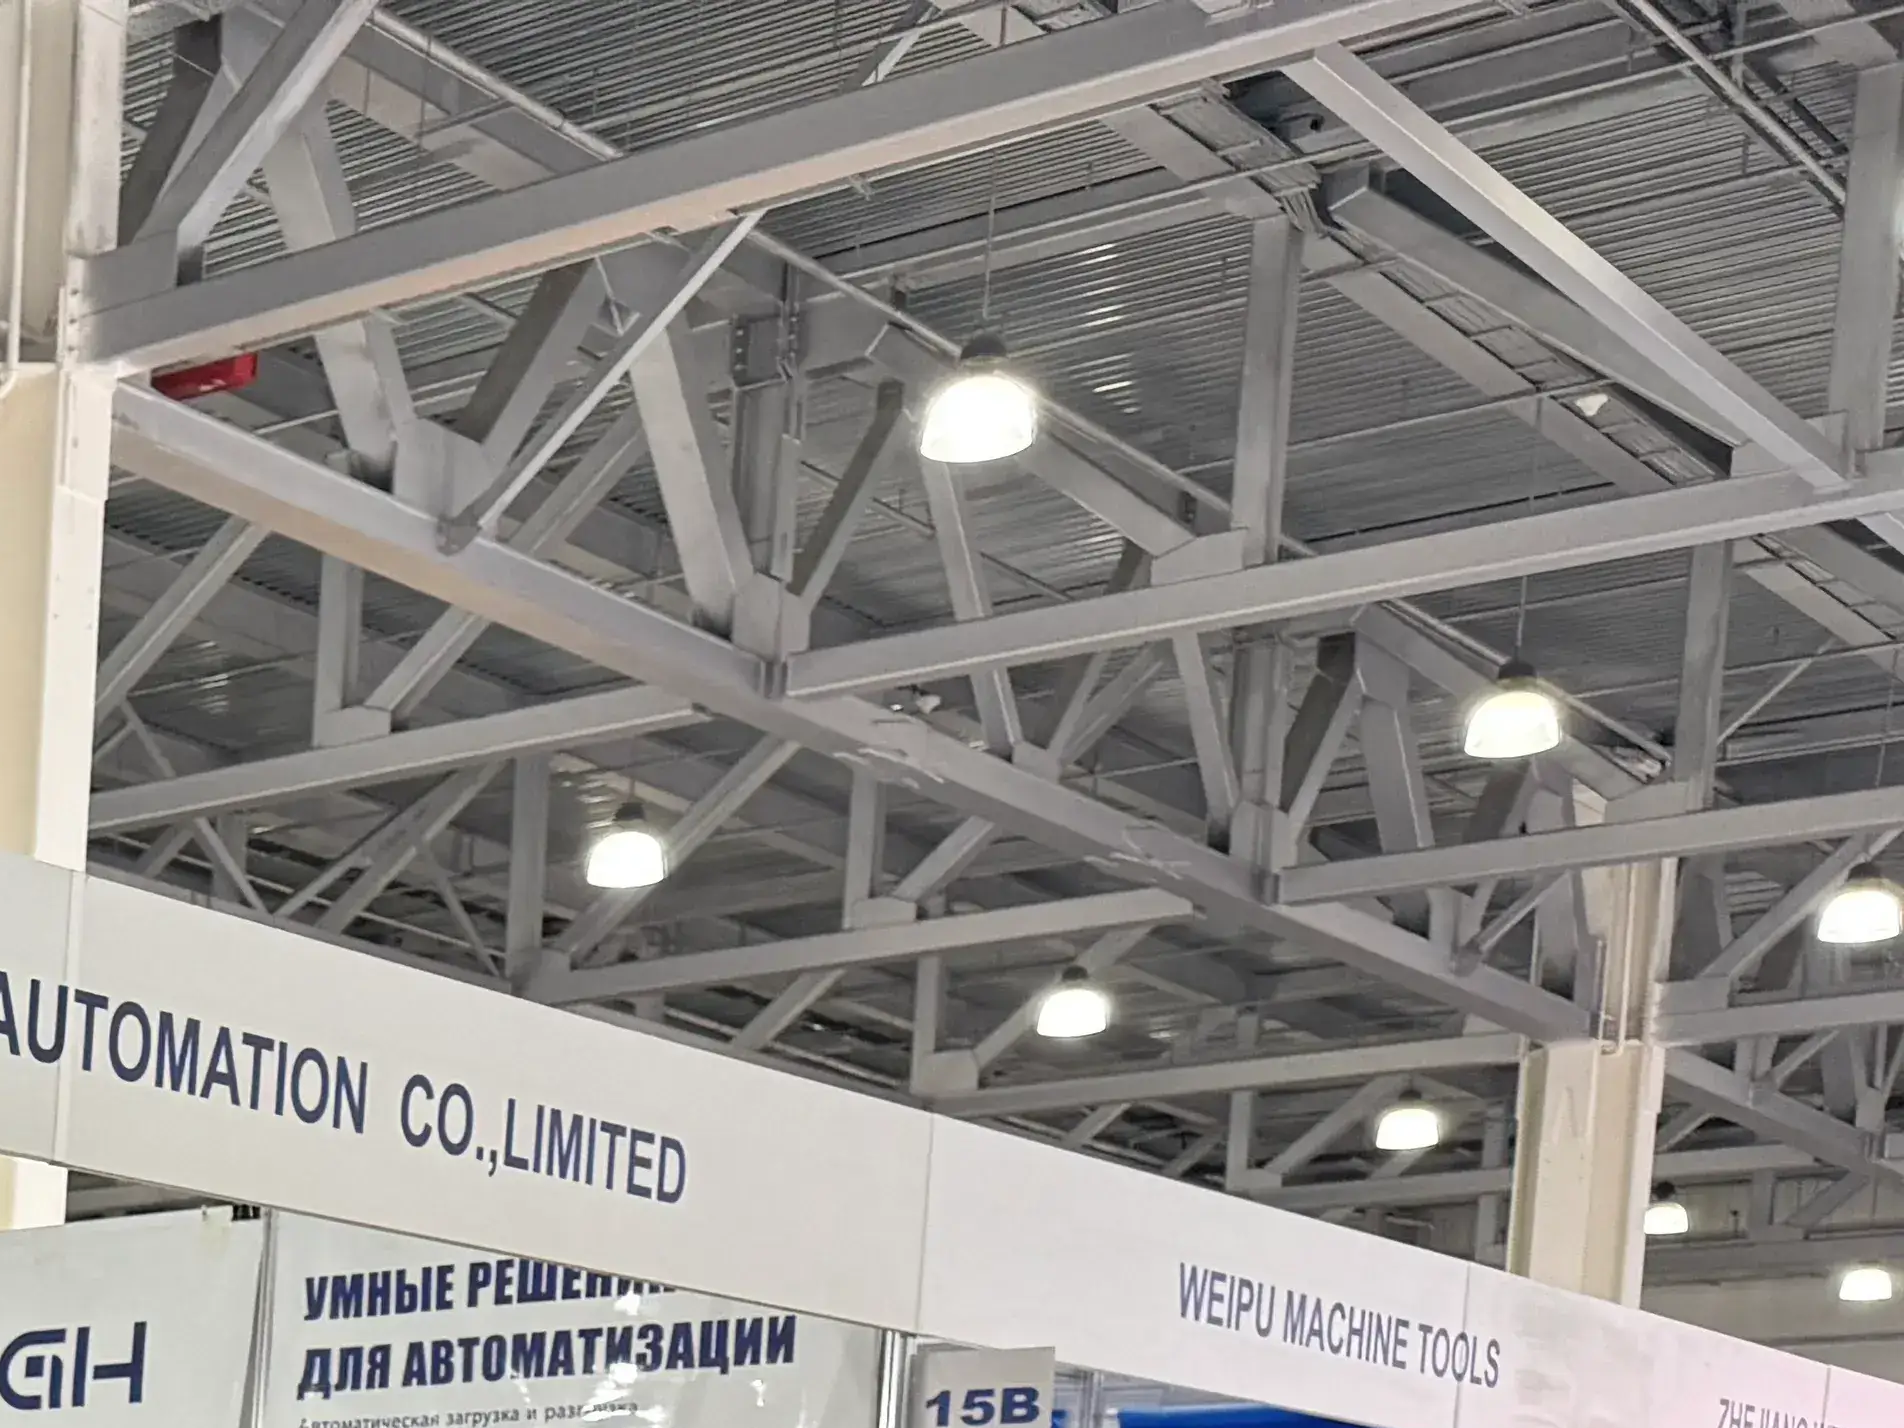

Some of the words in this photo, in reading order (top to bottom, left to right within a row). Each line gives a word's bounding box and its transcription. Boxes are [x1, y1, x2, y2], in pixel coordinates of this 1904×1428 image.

[401, 1074, 688, 1204] CO.,LIMITED
[304, 1264, 455, 1321] УМНЫЕ
[467, 1257, 676, 1308] РЕШЕН
[1179, 1262, 1276, 1338] WEIPU
[1282, 1290, 1410, 1370] MACHINE
[1417, 1323, 1501, 1388] TOOLS
[297, 1342, 391, 1400] ДЛЯ
[402, 1315, 797, 1389] АВТОМАТИЗАЦИИ
[445, 1407, 521, 1428] загрузка
[925, 1387, 1040, 1428] 15B
